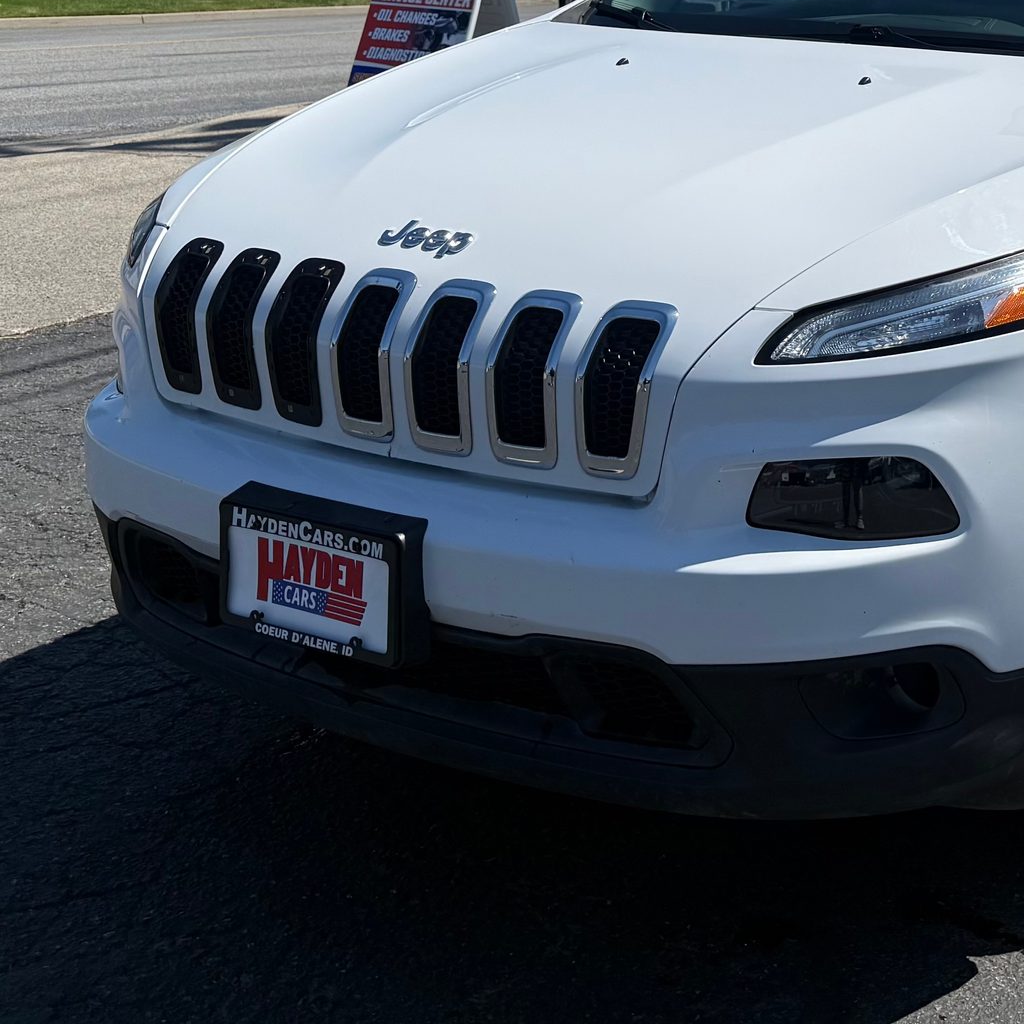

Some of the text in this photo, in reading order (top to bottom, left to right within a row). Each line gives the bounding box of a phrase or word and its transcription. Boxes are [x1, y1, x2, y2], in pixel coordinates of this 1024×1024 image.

[377, 9, 439, 26] OIL CHANGES
[372, 28, 410, 42] BRAKES
[366, 47, 430, 61] DIAGNOSTIC
[377, 219, 474, 260] Jeep
[256, 536, 364, 602] HAYDEN
[283, 585, 317, 610] CARS
[255, 622, 288, 641] COEUR
[341, 644, 354, 658] ID
